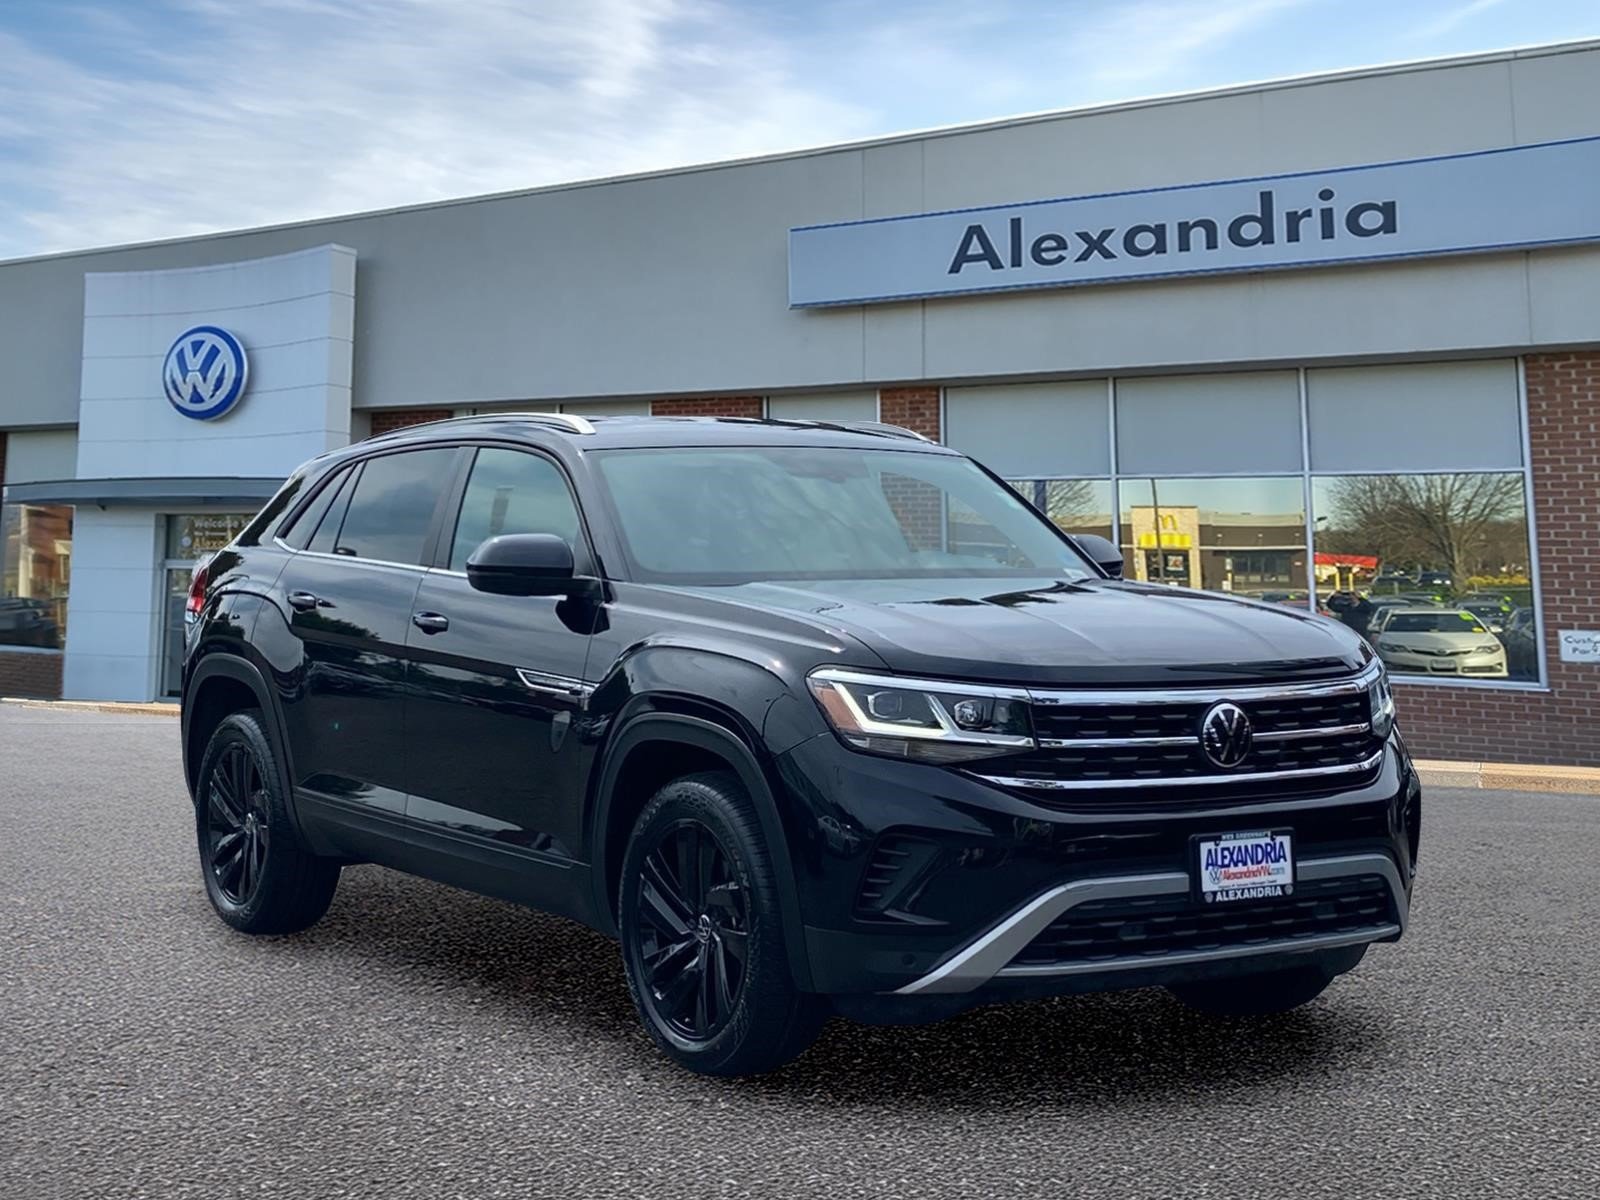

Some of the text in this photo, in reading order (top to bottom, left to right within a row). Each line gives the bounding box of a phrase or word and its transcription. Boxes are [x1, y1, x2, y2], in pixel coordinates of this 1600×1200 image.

[948, 188, 1398, 275] Alexandria
[1205, 840, 1288, 871] ALEXANDRIA
[1216, 885, 1283, 902] ALEXANDRIA
